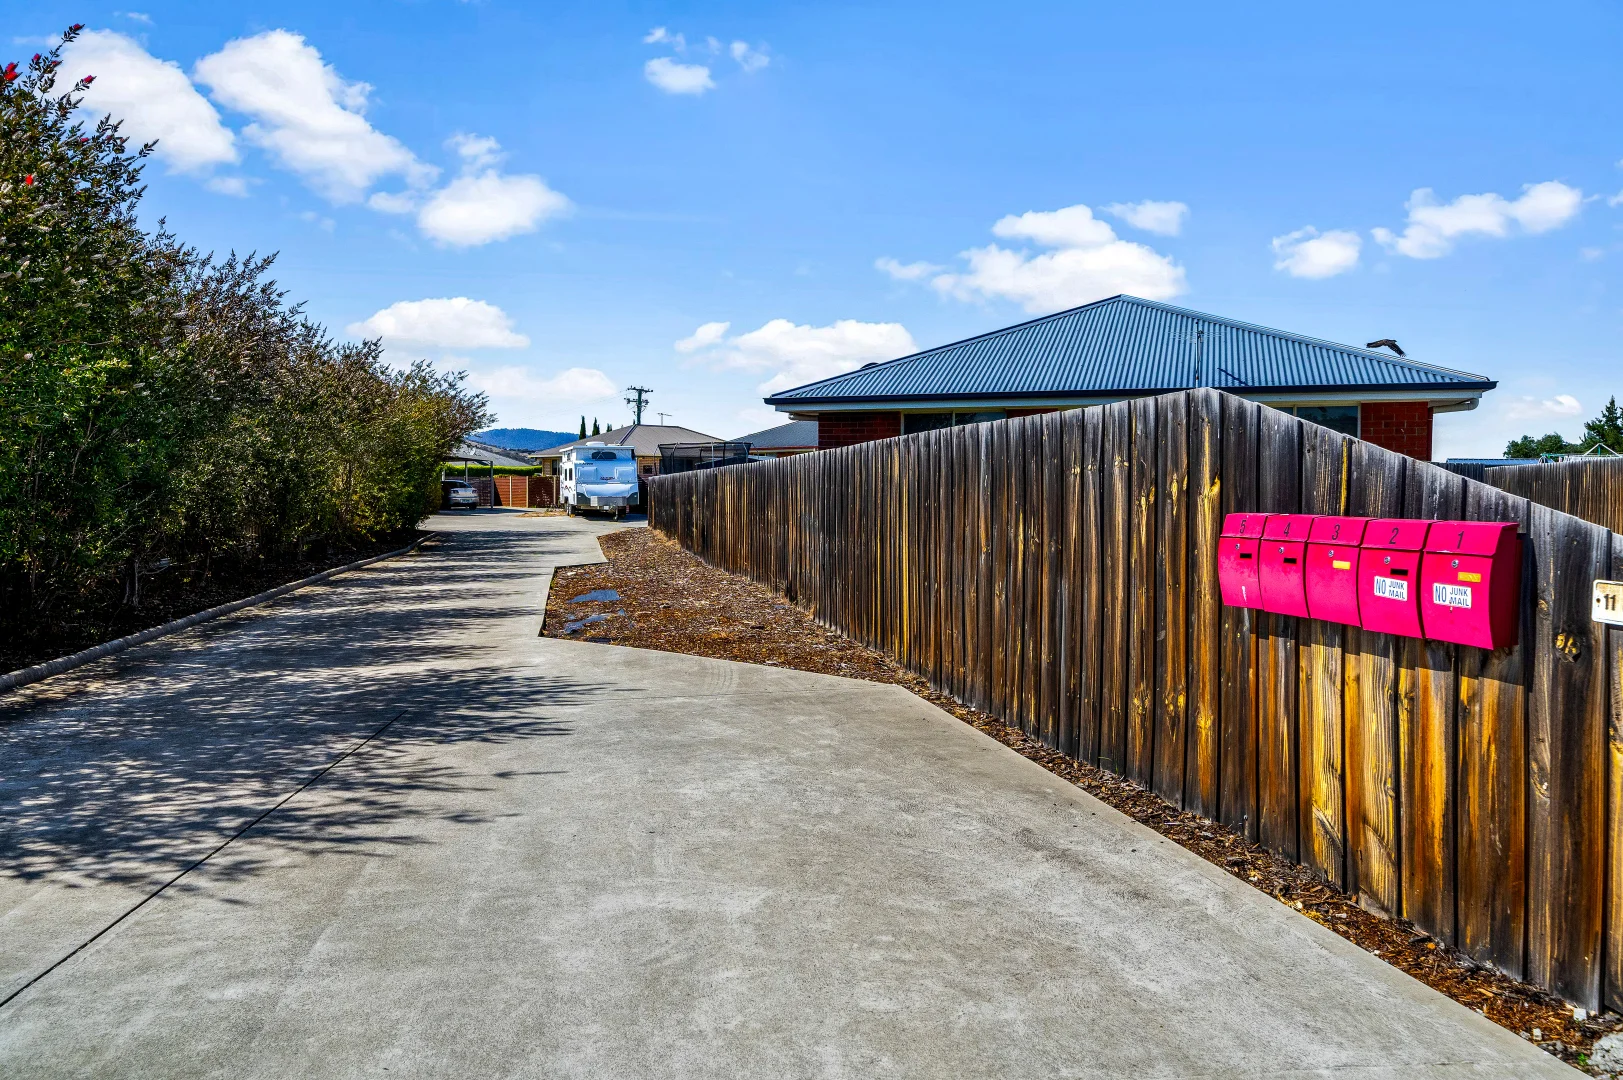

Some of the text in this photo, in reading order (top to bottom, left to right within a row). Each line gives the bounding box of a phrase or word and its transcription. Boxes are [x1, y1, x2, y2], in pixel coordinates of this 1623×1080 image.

[1240, 520, 1247, 534] 5
[1283, 522, 1291, 537] 4
[1331, 524, 1340, 540] 3
[1388, 527, 1399, 544] 2
[1457, 530, 1464, 549] 1
[1375, 578, 1405, 595] NO JUNK
[1389, 589, 1406, 600] MAIL
[1435, 585, 1468, 603] NO JUNK
[1449, 596, 1470, 606] MAIL
[1603, 593, 1616, 611] 11
